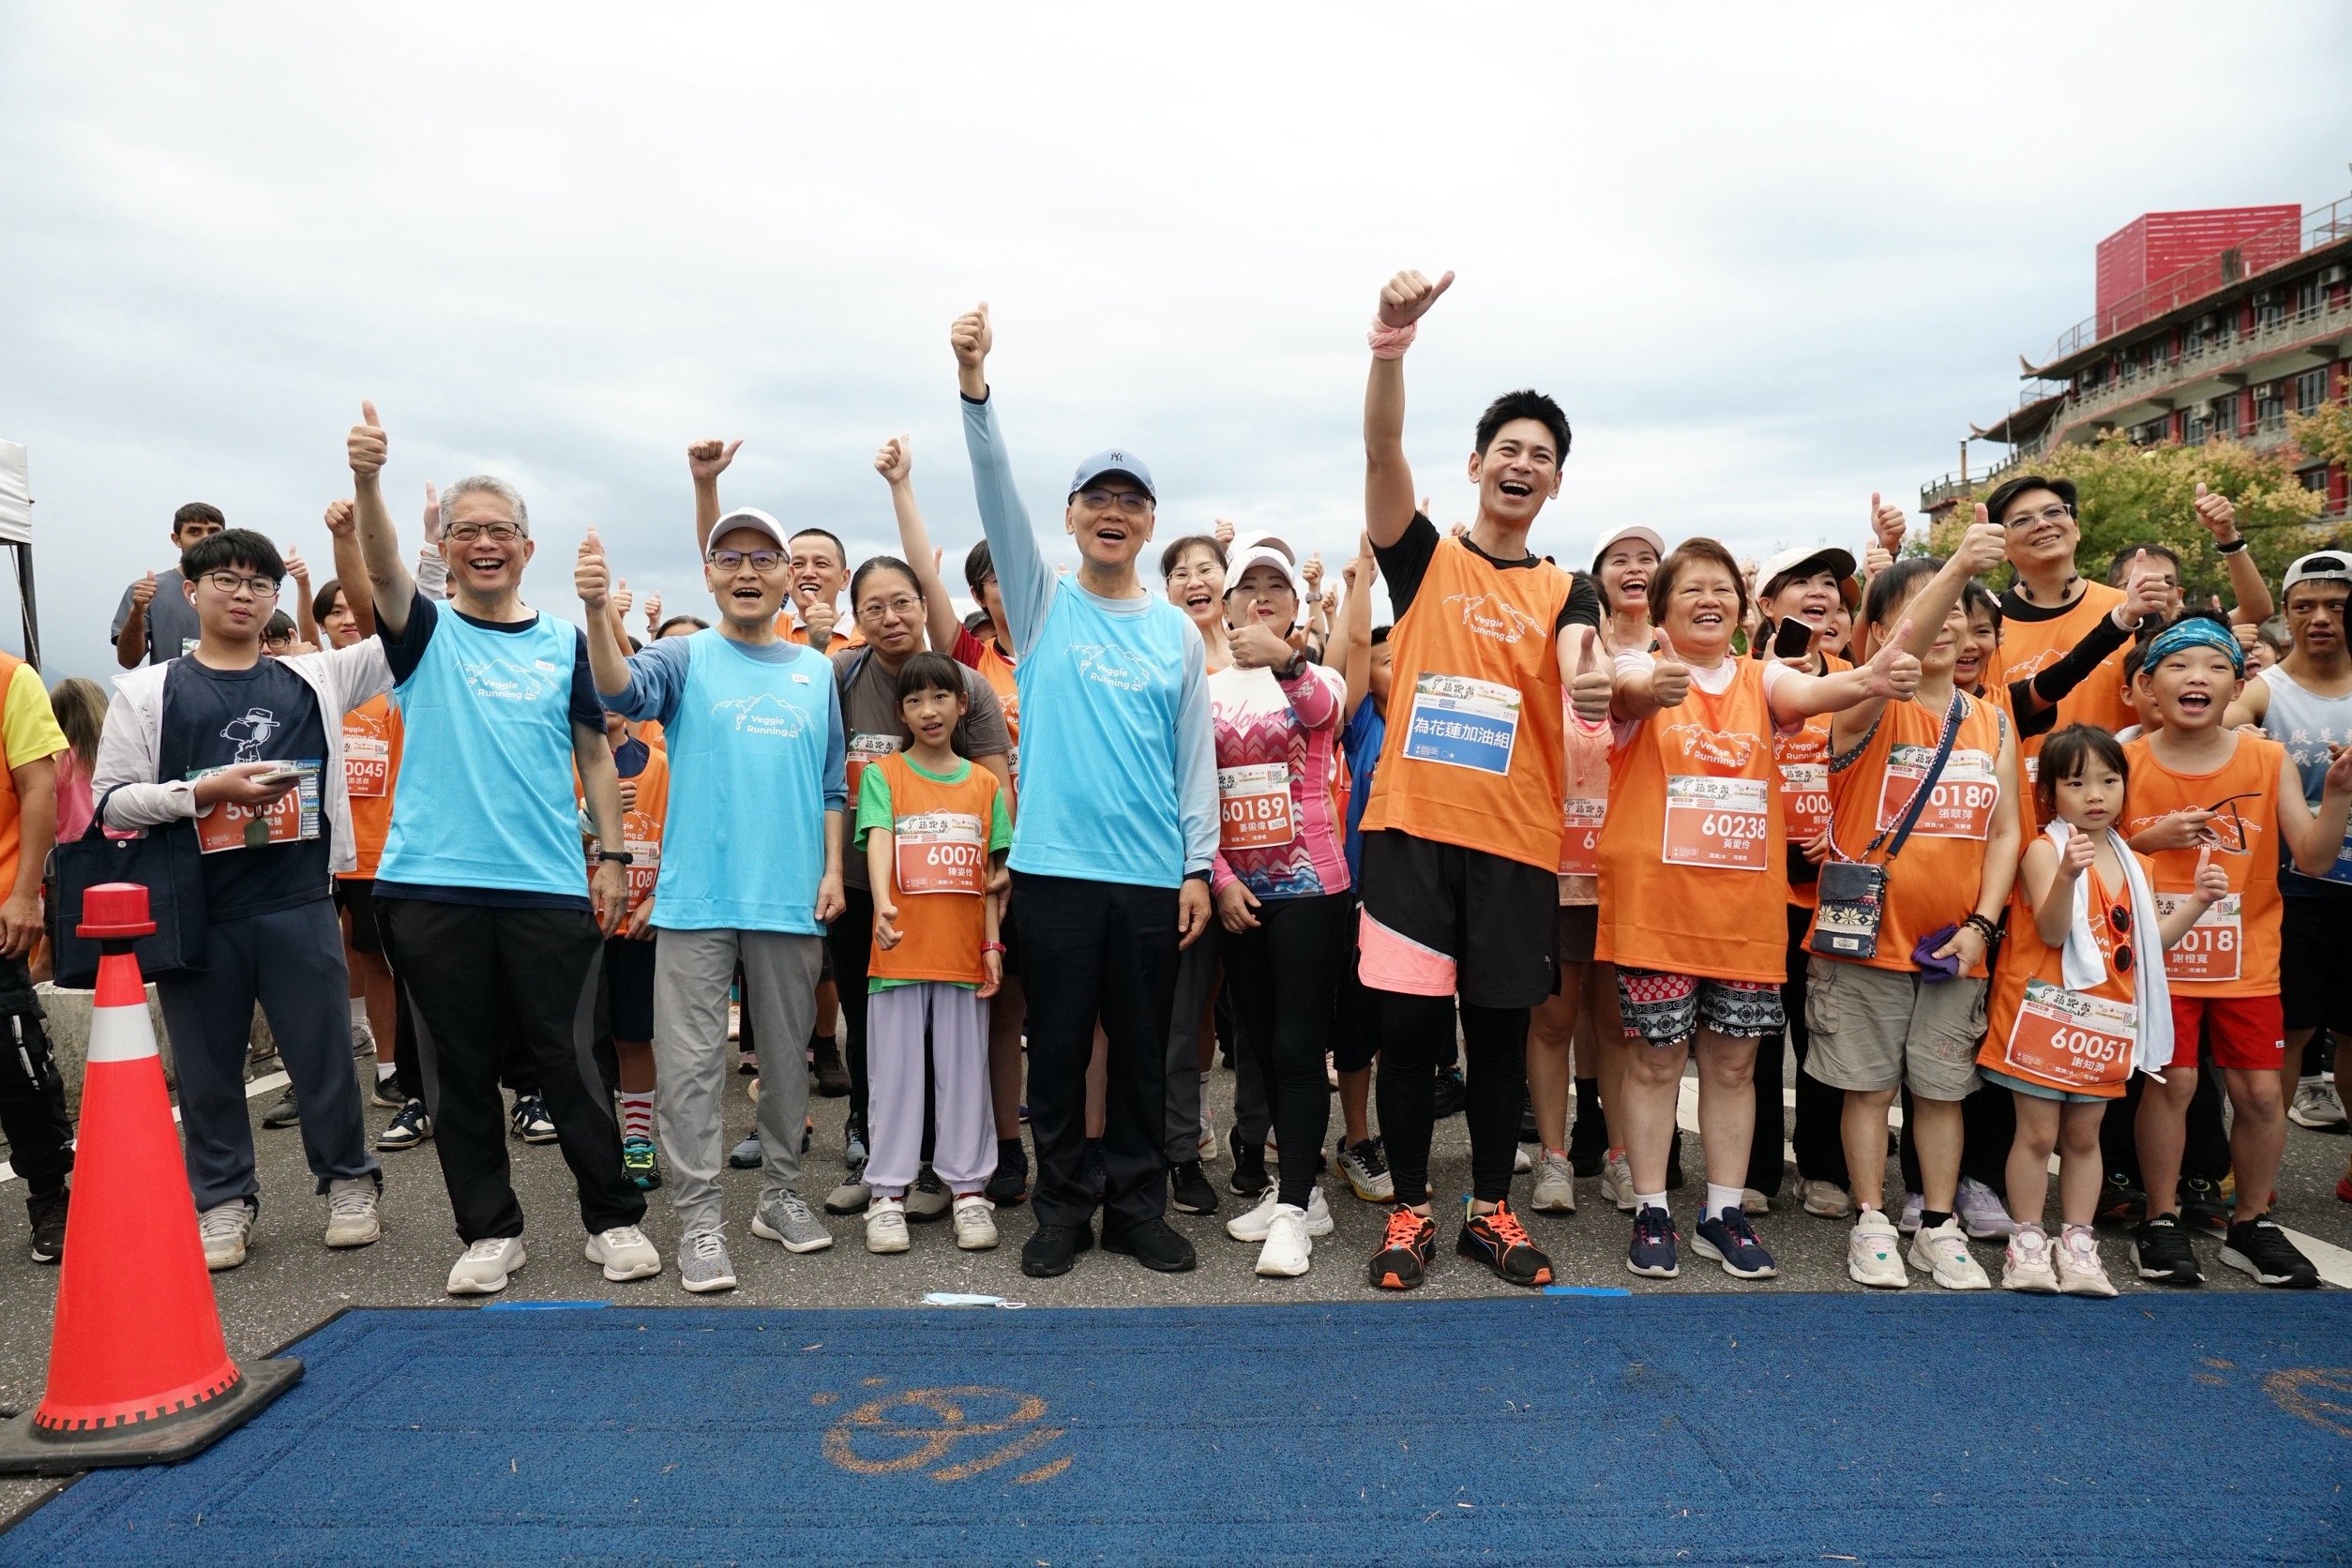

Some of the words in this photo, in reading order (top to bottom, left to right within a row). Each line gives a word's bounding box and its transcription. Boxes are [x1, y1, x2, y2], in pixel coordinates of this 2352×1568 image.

[1473, 613, 1504, 628] Veggie
[1095, 662, 1128, 677] Veggie
[482, 678, 519, 689] Veggie
[1090, 672, 1130, 690] Running
[477, 688, 522, 701] Running
[751, 715, 785, 726] Veggie
[746, 725, 789, 737] Running
[1413, 716, 1511, 749] 為花蓮加油組
[1786, 751, 1821, 760] Running
[1788, 742, 1819, 751] Veggie
[1694, 750, 1737, 768] Running
[1795, 794, 1832, 814] 600
[1925, 785, 1994, 809] 0180
[1222, 796, 1285, 822] 60189
[1701, 813, 1766, 840] 60238
[1583, 830, 1601, 850] 6
[927, 845, 982, 868] 60074
[2050, 1027, 2127, 1064] 60051
